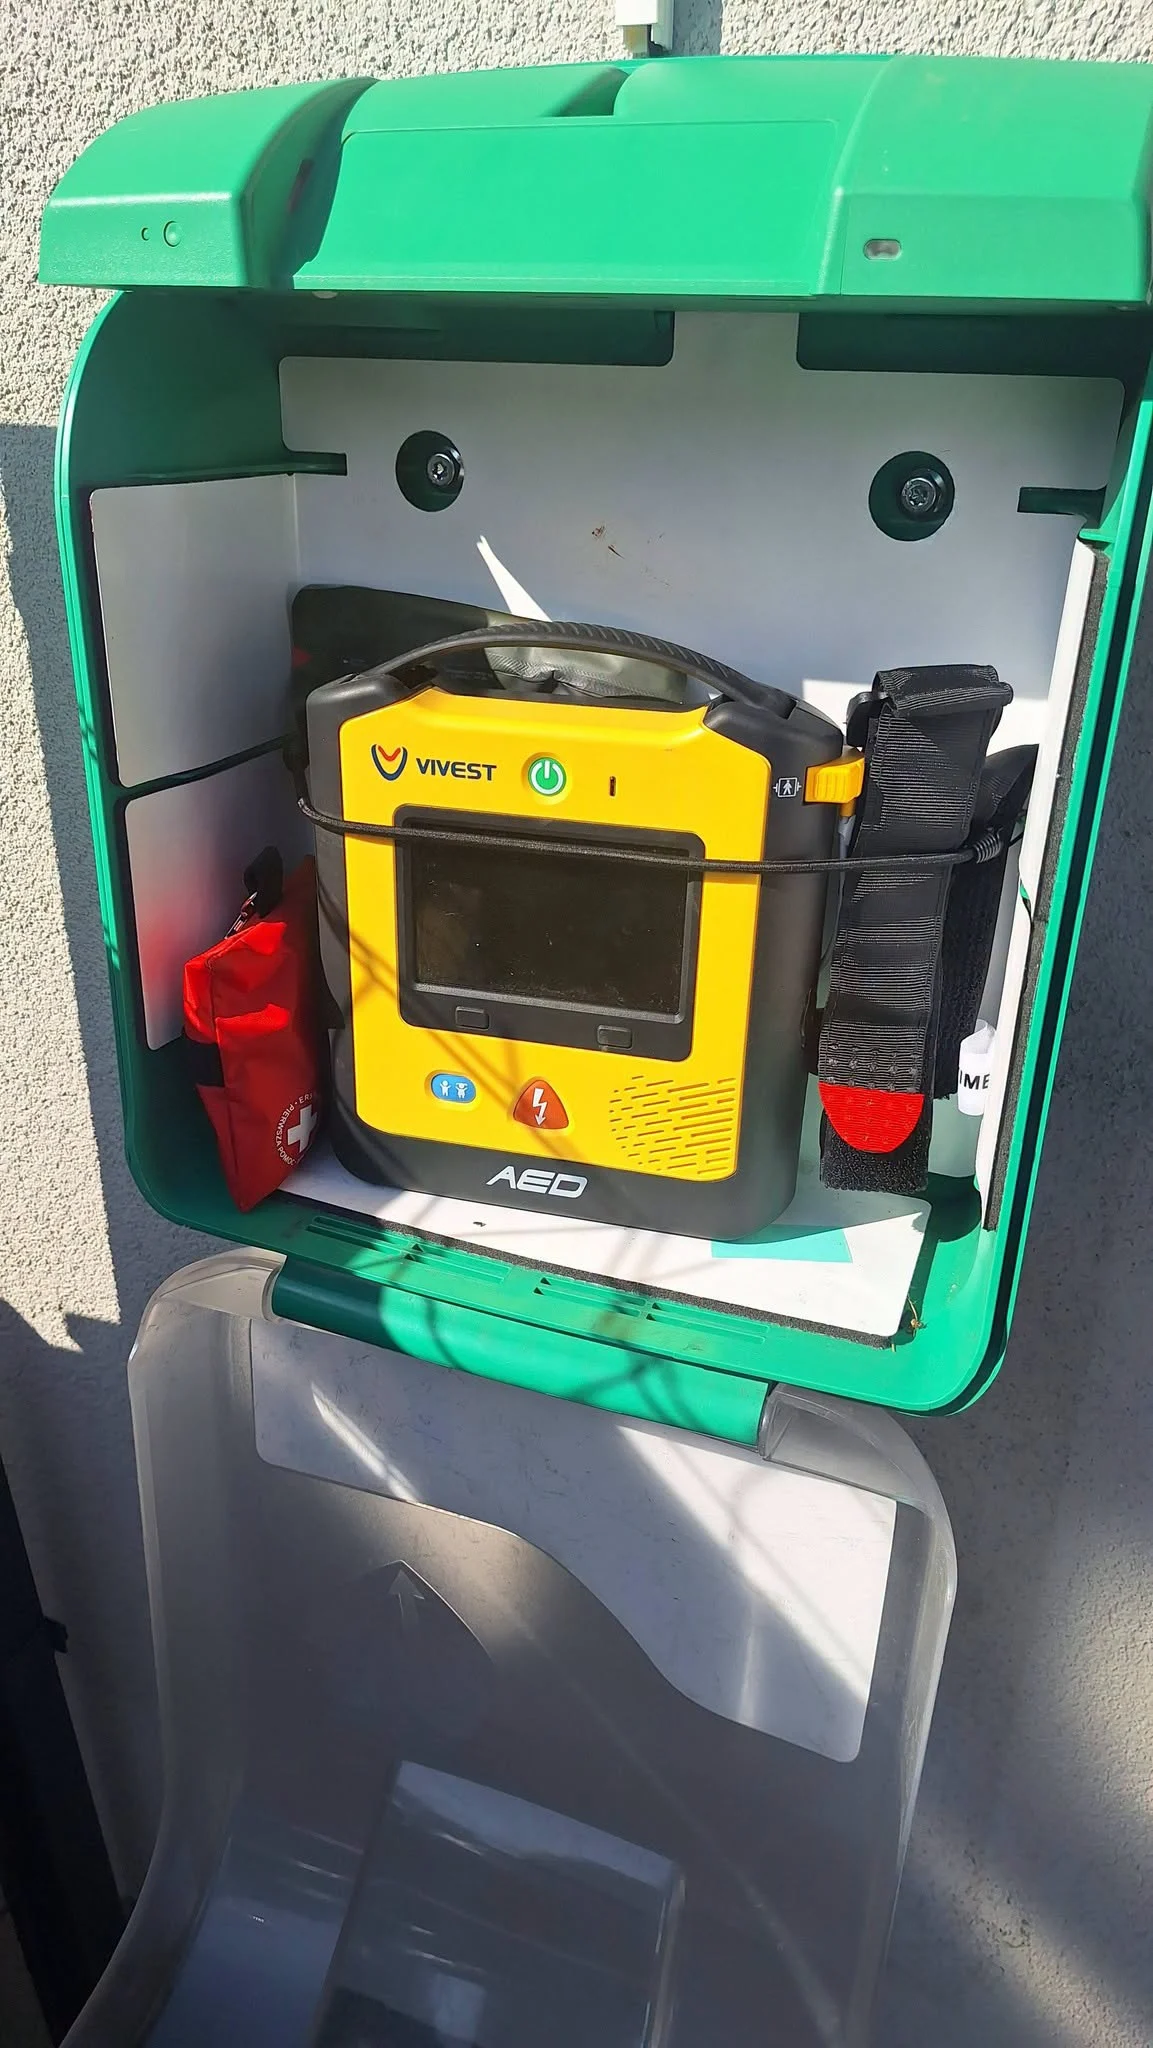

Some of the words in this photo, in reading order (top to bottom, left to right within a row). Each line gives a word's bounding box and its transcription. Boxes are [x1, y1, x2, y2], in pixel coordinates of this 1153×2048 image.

[415, 757, 497, 781] VIVEST
[959, 1069, 990, 1090] IME
[276, 1103, 295, 1147] PIERWSZA
[486, 1165, 588, 1199] AED
